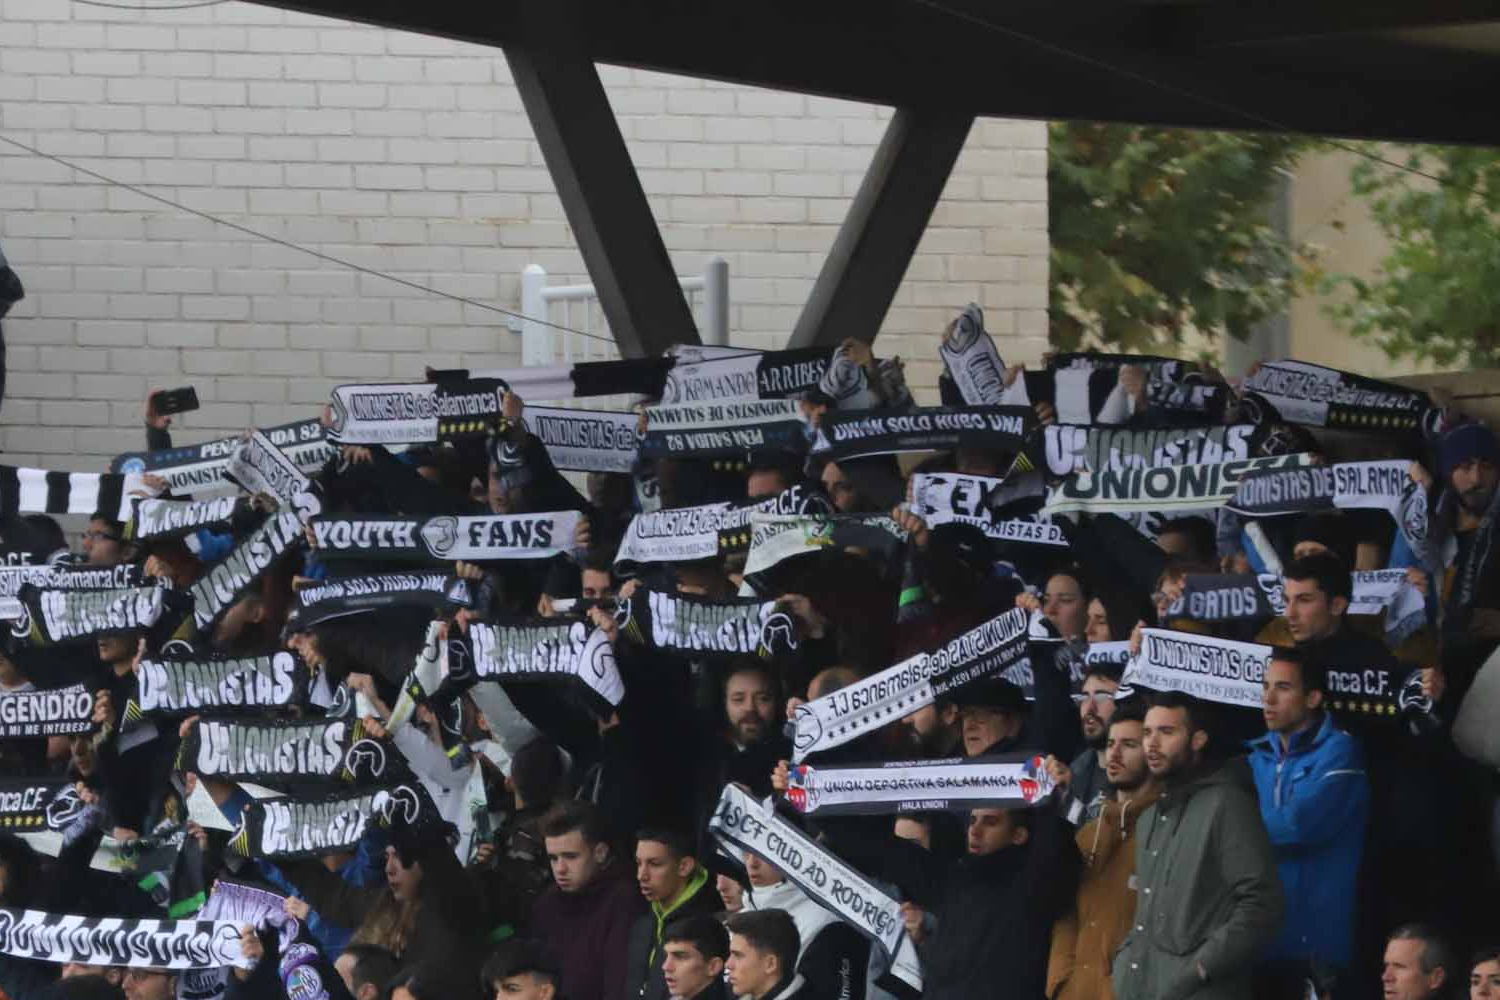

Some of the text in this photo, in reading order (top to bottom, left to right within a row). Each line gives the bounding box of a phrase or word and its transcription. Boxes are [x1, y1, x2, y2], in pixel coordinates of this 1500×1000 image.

[313, 520, 553, 548] YOUTH FANS
[1190, 589, 1258, 618] GATOS
[469, 621, 590, 677] UNIONISTAS
[1148, 634, 1241, 679] UNIONISTAS
[1242, 657, 1264, 683] de
[138, 651, 295, 711] UNIONISTAS
[1361, 669, 1392, 696] C.F.
[9, 724, 20, 735] MI
[25, 724, 39, 734] ME
[199, 721, 346, 775] UNIONISTAS
[22, 786, 47, 811] C.F.
[830, 878, 896, 936] RODRIGO
[10, 918, 211, 964] UNIONISTAS
